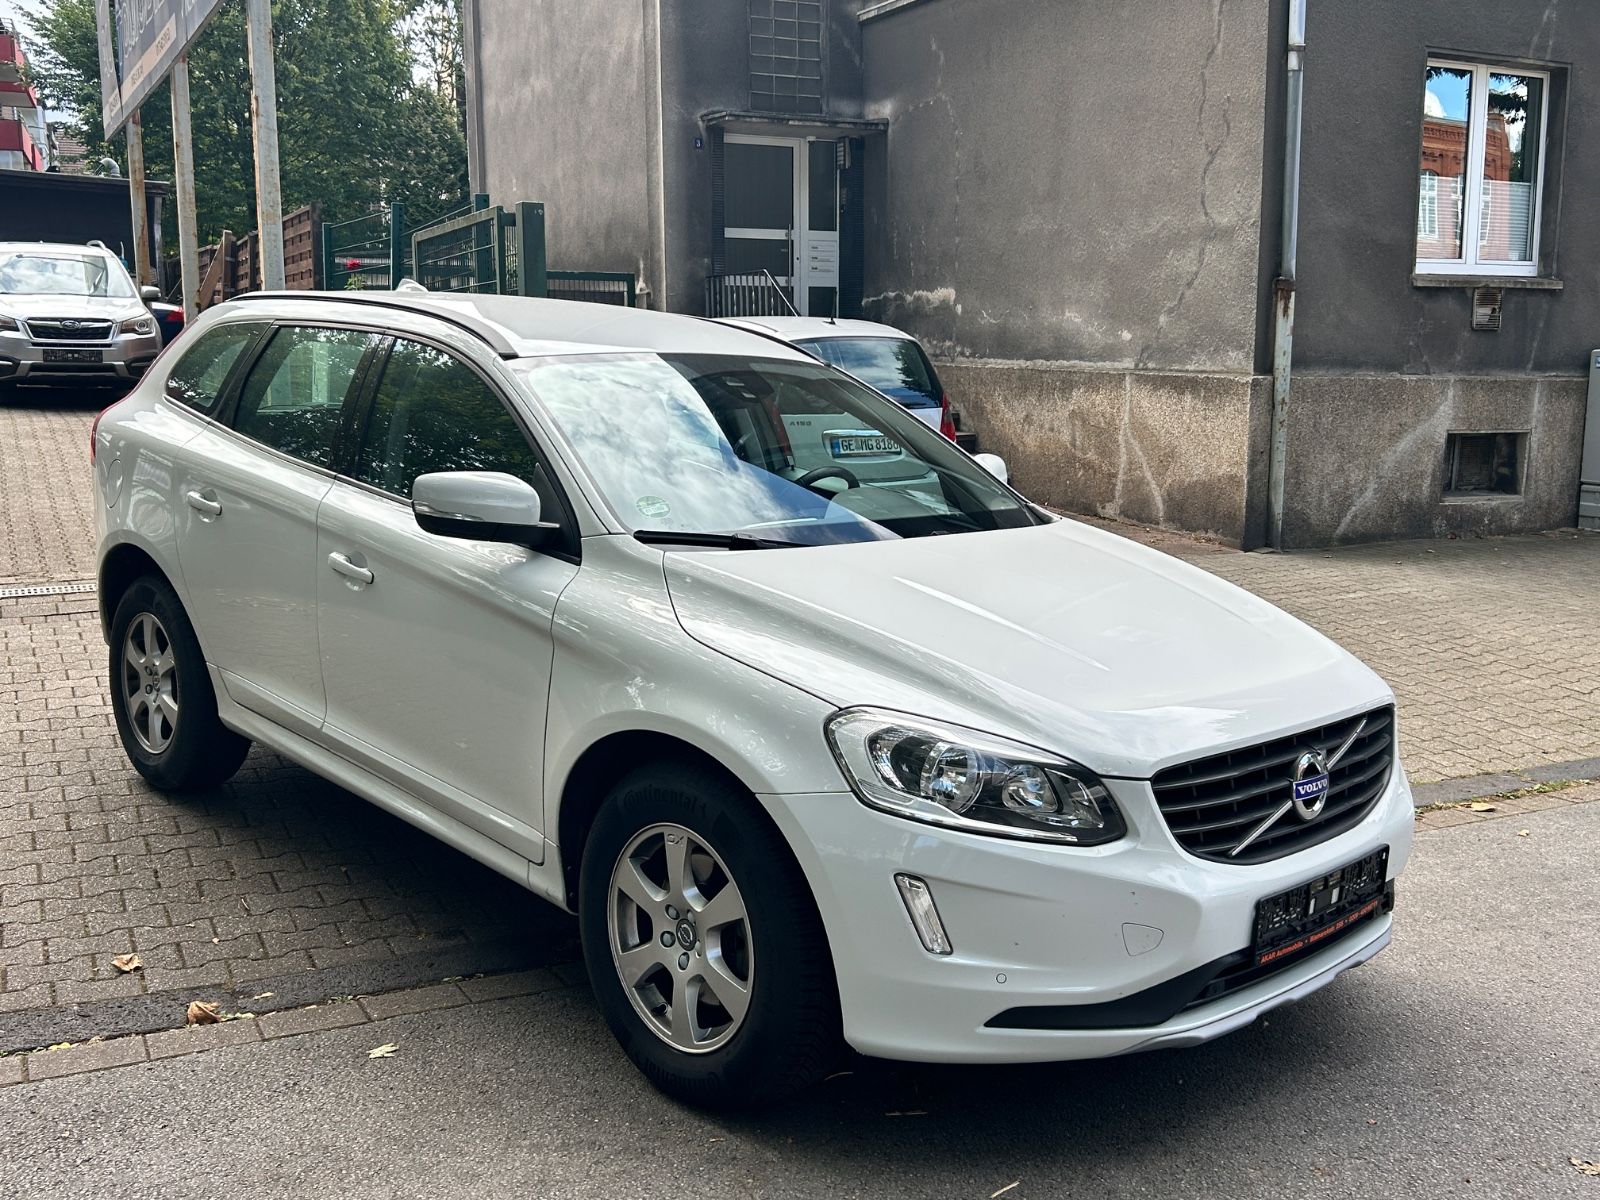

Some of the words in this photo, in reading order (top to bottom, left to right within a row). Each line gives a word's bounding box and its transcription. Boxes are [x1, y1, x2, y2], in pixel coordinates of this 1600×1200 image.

[841, 439, 856, 452] GE
[860, 438, 874, 451] MG
[1297, 778, 1328, 795] VOLVO
